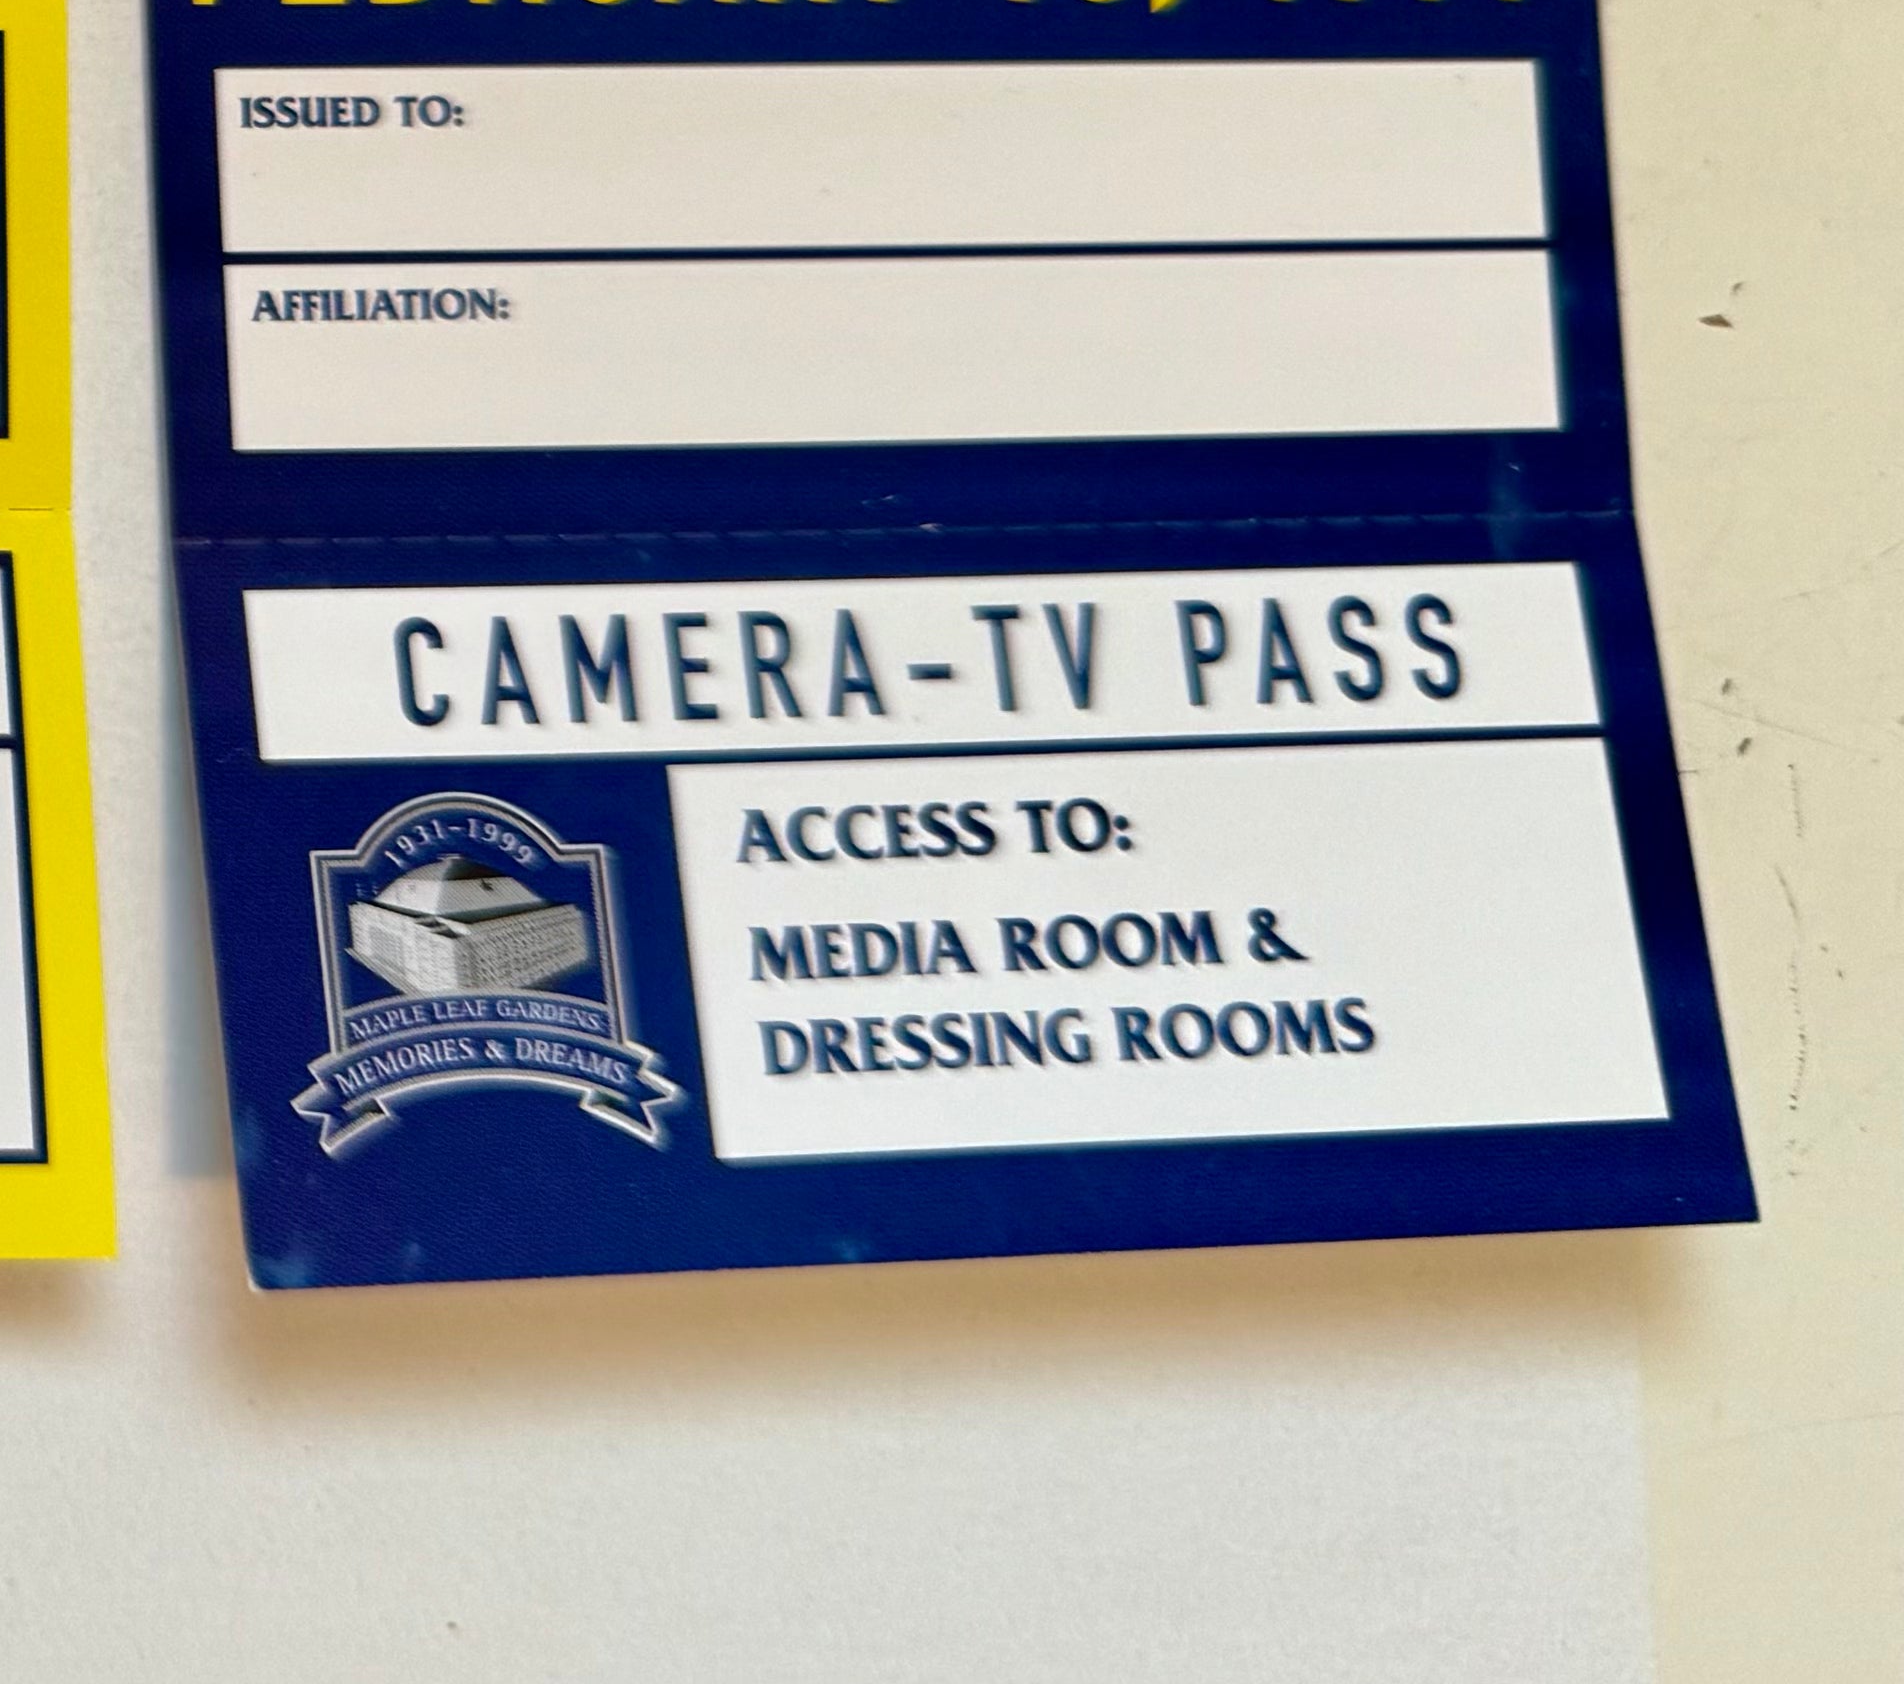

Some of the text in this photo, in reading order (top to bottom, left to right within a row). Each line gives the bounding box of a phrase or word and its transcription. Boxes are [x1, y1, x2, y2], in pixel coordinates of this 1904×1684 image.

[238, 95, 465, 130] ISSUED TO:
[251, 287, 512, 323] AFFILIATION:
[395, 592, 1465, 730] CAMERA-TV PASS
[386, 818, 534, 867] 1931-1999
[735, 796, 1135, 867] ACCESS TO:
[749, 905, 1309, 983] MEDIA ROOM &
[352, 998, 600, 1038] MAPLE LEAF GARDENS
[760, 998, 1378, 1078] DRESSING ROOMS
[337, 1037, 629, 1094] MEMORIES & DREAMS
